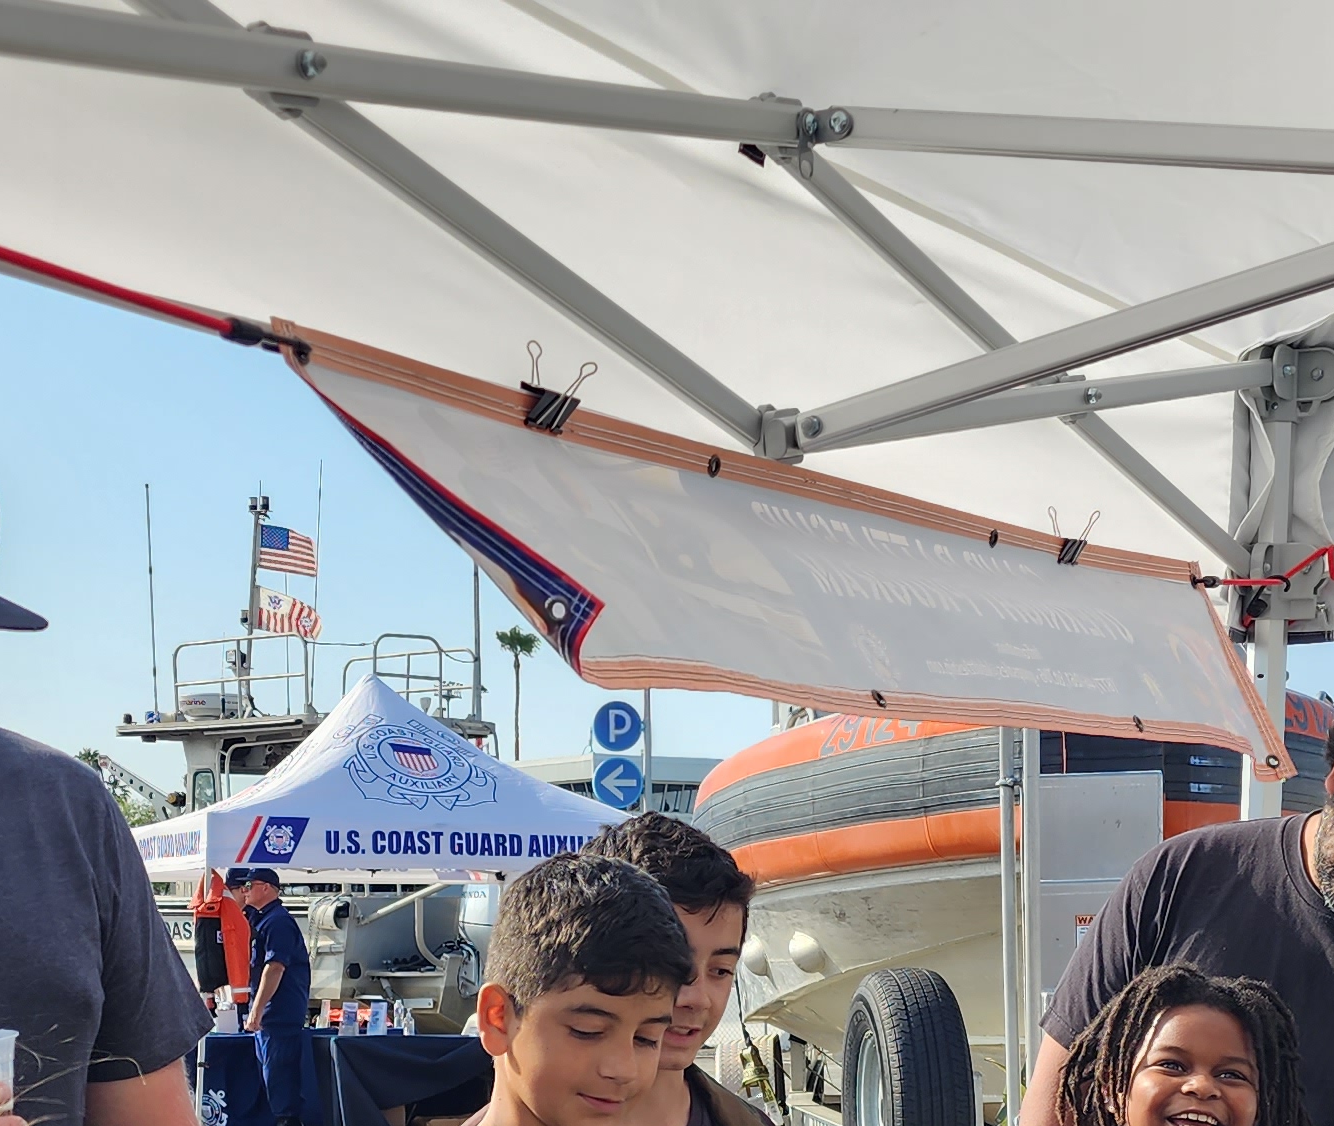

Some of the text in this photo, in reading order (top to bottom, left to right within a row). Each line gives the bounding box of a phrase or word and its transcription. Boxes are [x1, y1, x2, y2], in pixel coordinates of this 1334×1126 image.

[609, 710, 633, 743] P
[368, 727, 417, 741] COAST
[423, 737, 466, 768] GUARD
[386, 772, 461, 790] AUXILIARY
[325, 830, 594, 858] U.S. COAST GUARD AUXIL
